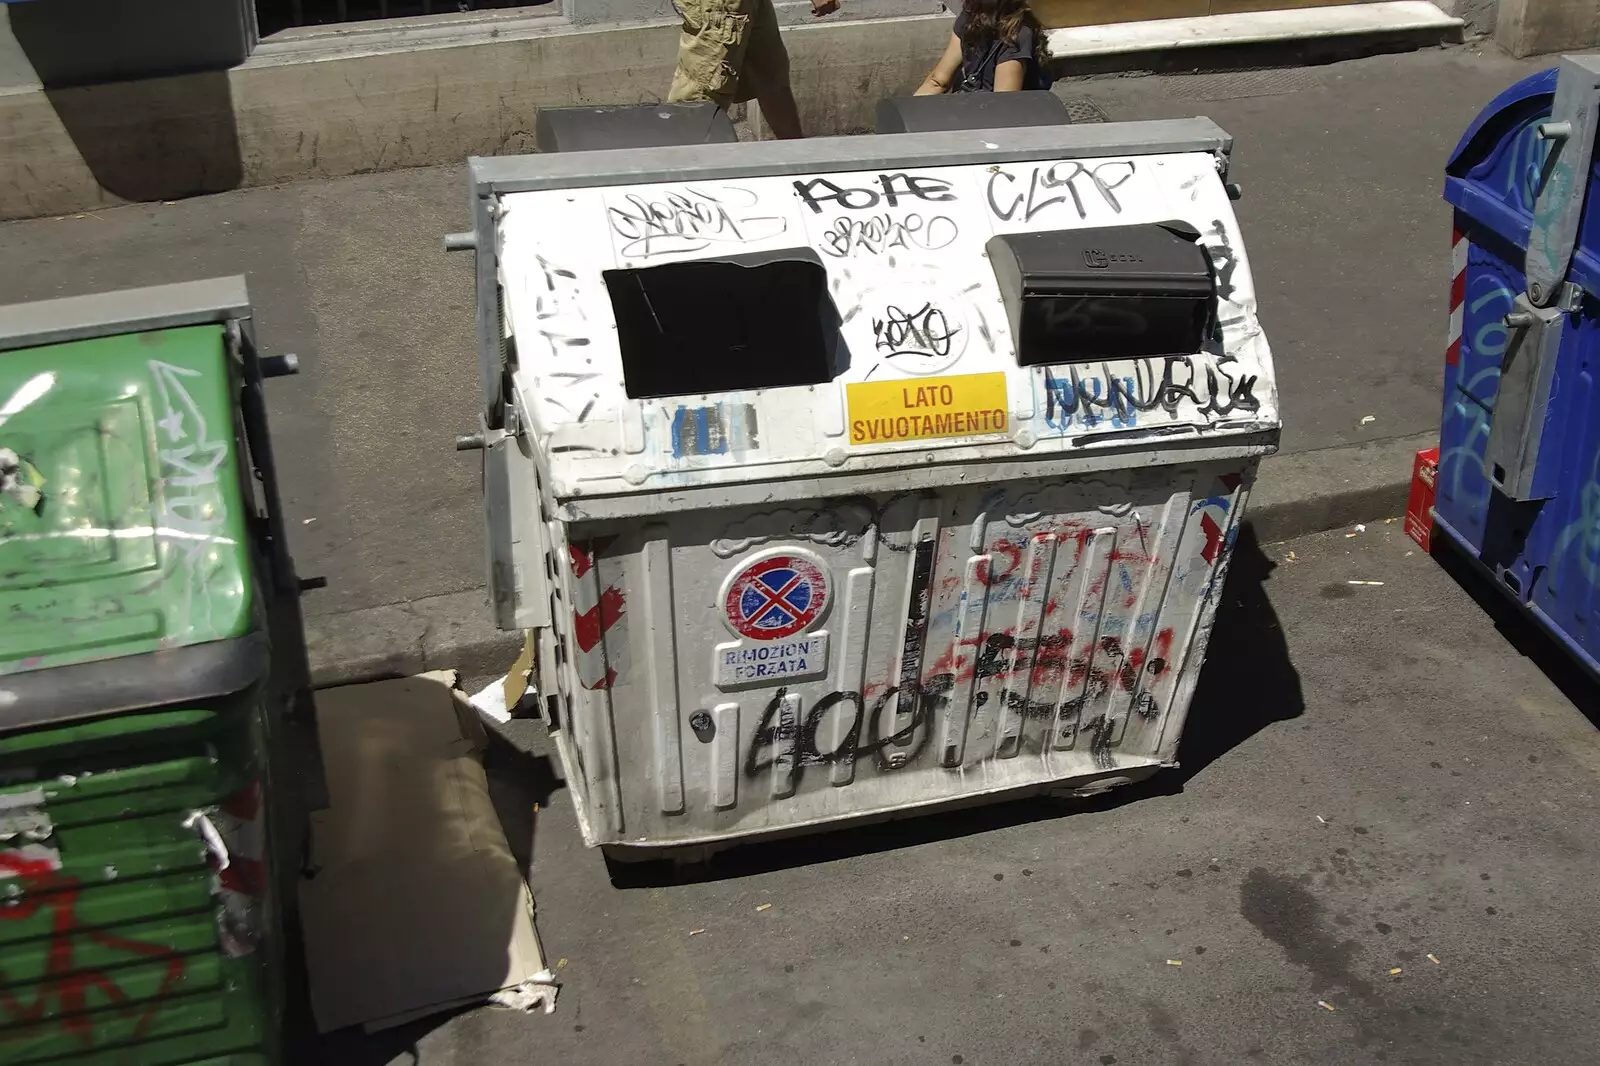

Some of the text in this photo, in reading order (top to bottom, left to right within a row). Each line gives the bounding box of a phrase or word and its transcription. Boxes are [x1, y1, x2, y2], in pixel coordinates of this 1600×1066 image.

[903, 384, 953, 408] LATO
[853, 408, 1005, 442] SVUOTAMENTO
[725, 640, 819, 665] RIMOZIONE
[735, 659, 807, 678] FORZATA
